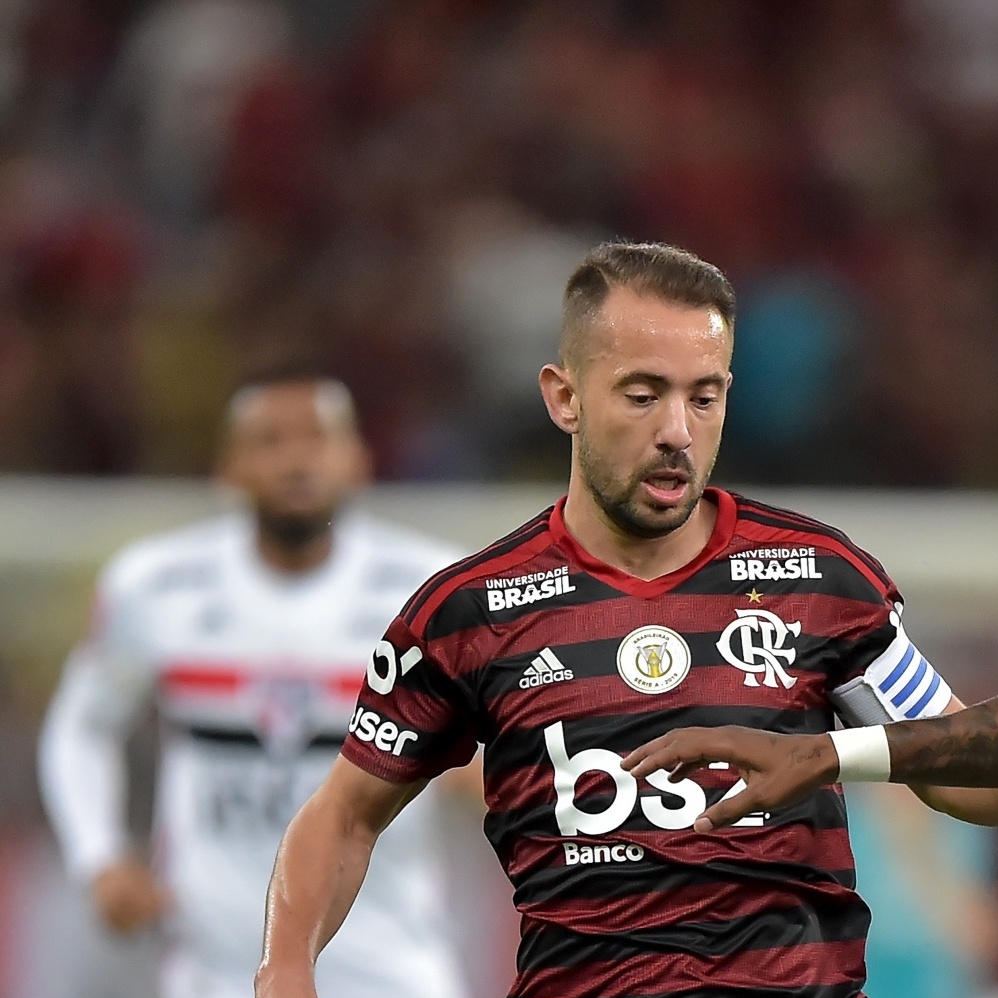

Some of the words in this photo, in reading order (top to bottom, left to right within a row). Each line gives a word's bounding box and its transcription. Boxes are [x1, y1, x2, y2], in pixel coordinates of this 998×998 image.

[486, 565, 569, 590] UNIVERSIDADE
[730, 557, 823, 581] BRASIL
[486, 574, 577, 612] BRASIL
[518, 668, 574, 689] adidas
[562, 842, 645, 866] Banco
